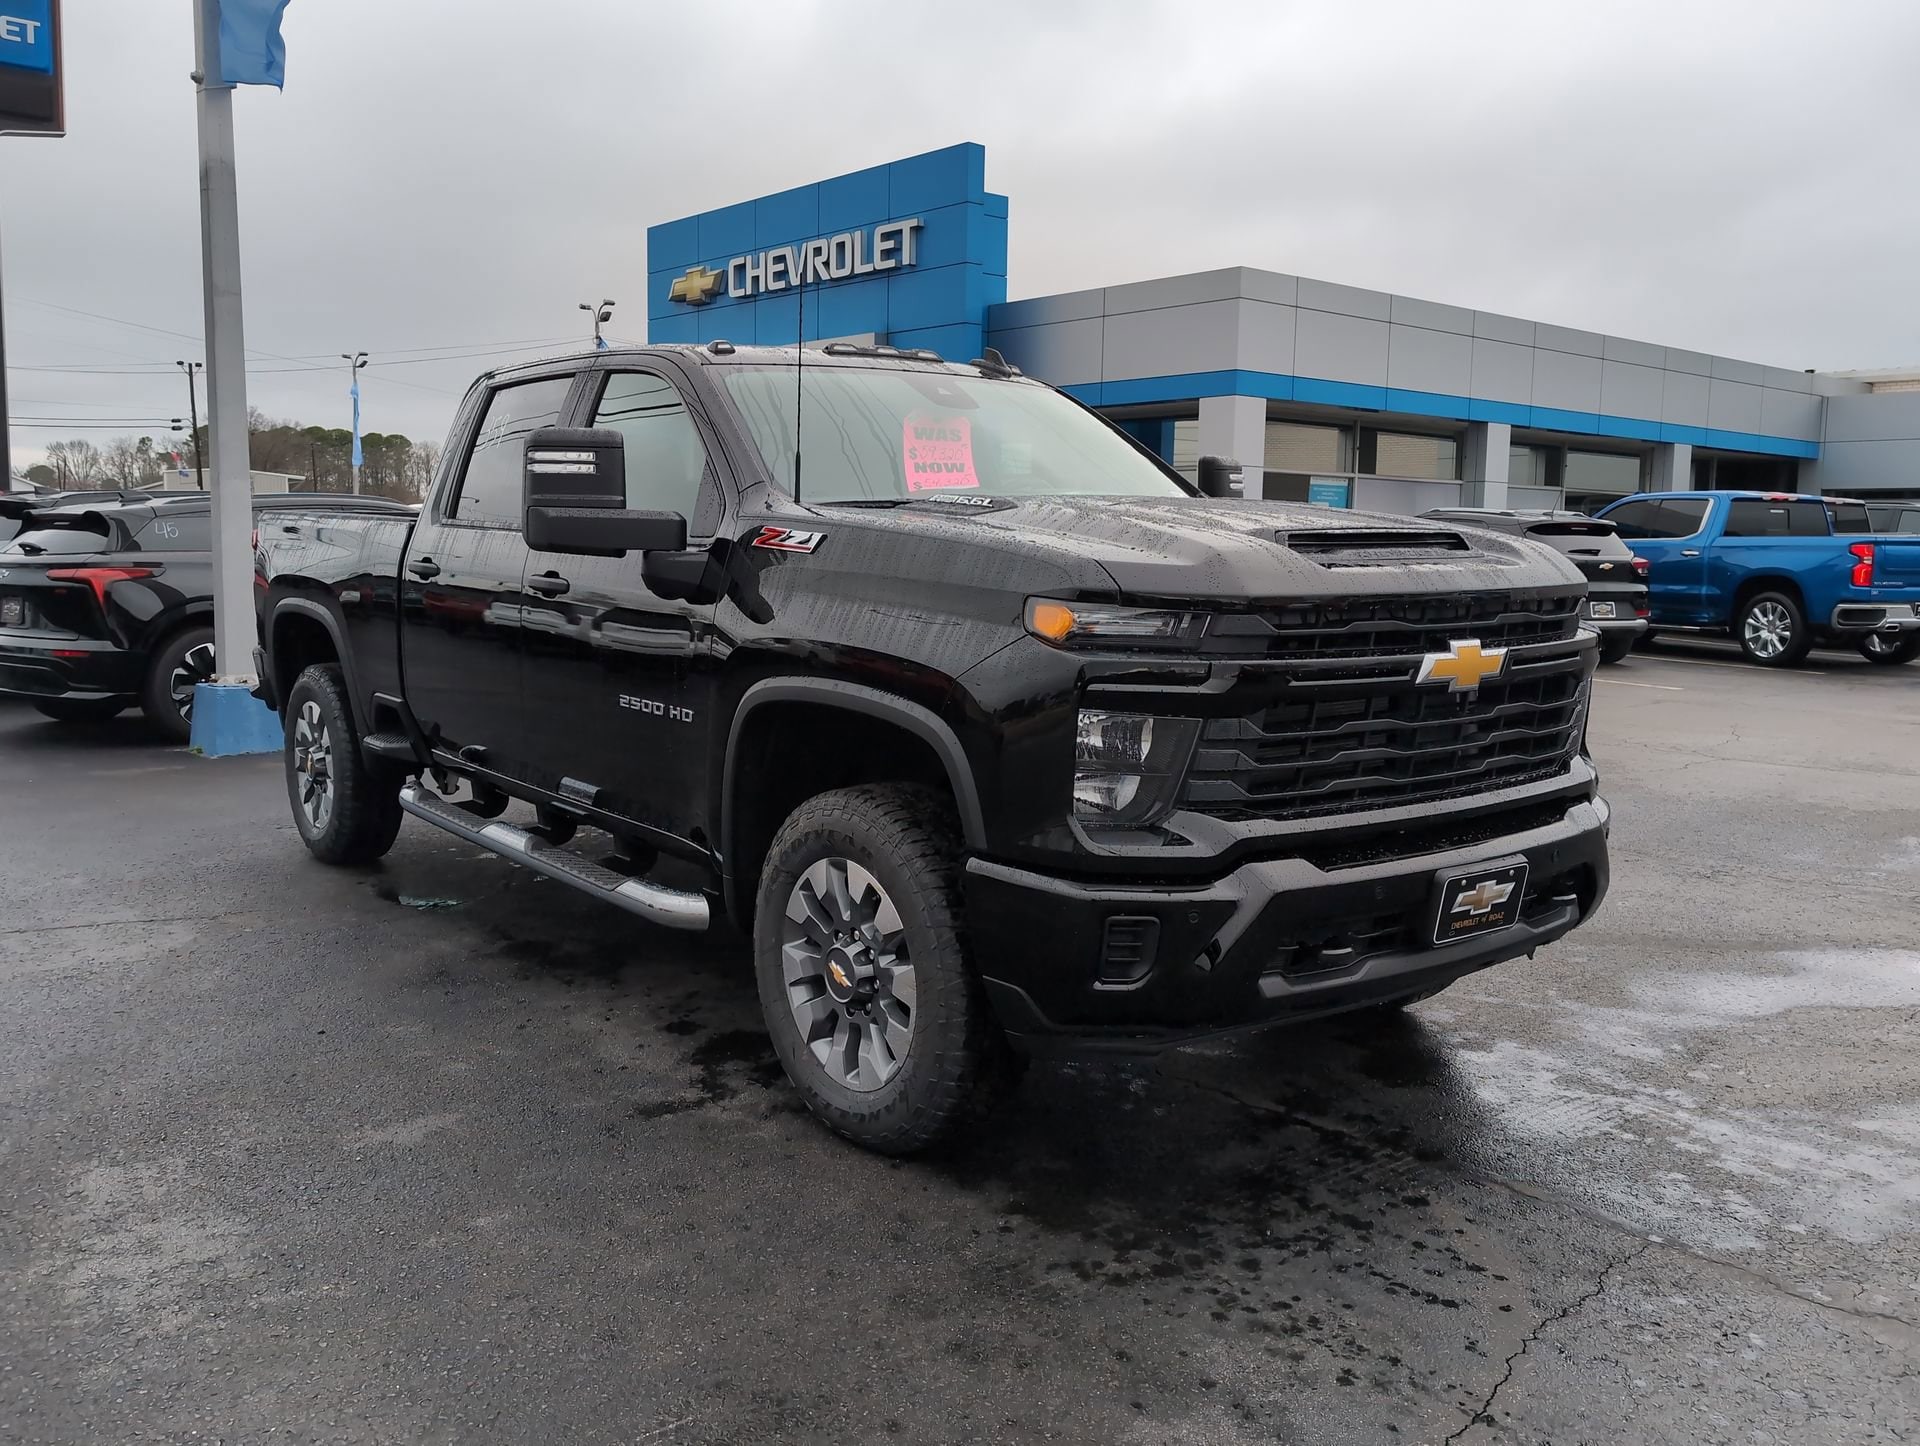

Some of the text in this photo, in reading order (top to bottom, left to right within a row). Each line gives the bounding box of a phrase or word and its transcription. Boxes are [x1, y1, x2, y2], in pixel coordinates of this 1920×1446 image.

[728, 217, 924, 298] CHEVROLET
[913, 428, 961, 441] WAS
[913, 462, 965, 474] NOW
[155, 522, 178, 538] 45
[752, 526, 827, 553] Z71
[619, 694, 694, 723] 2500 HD
